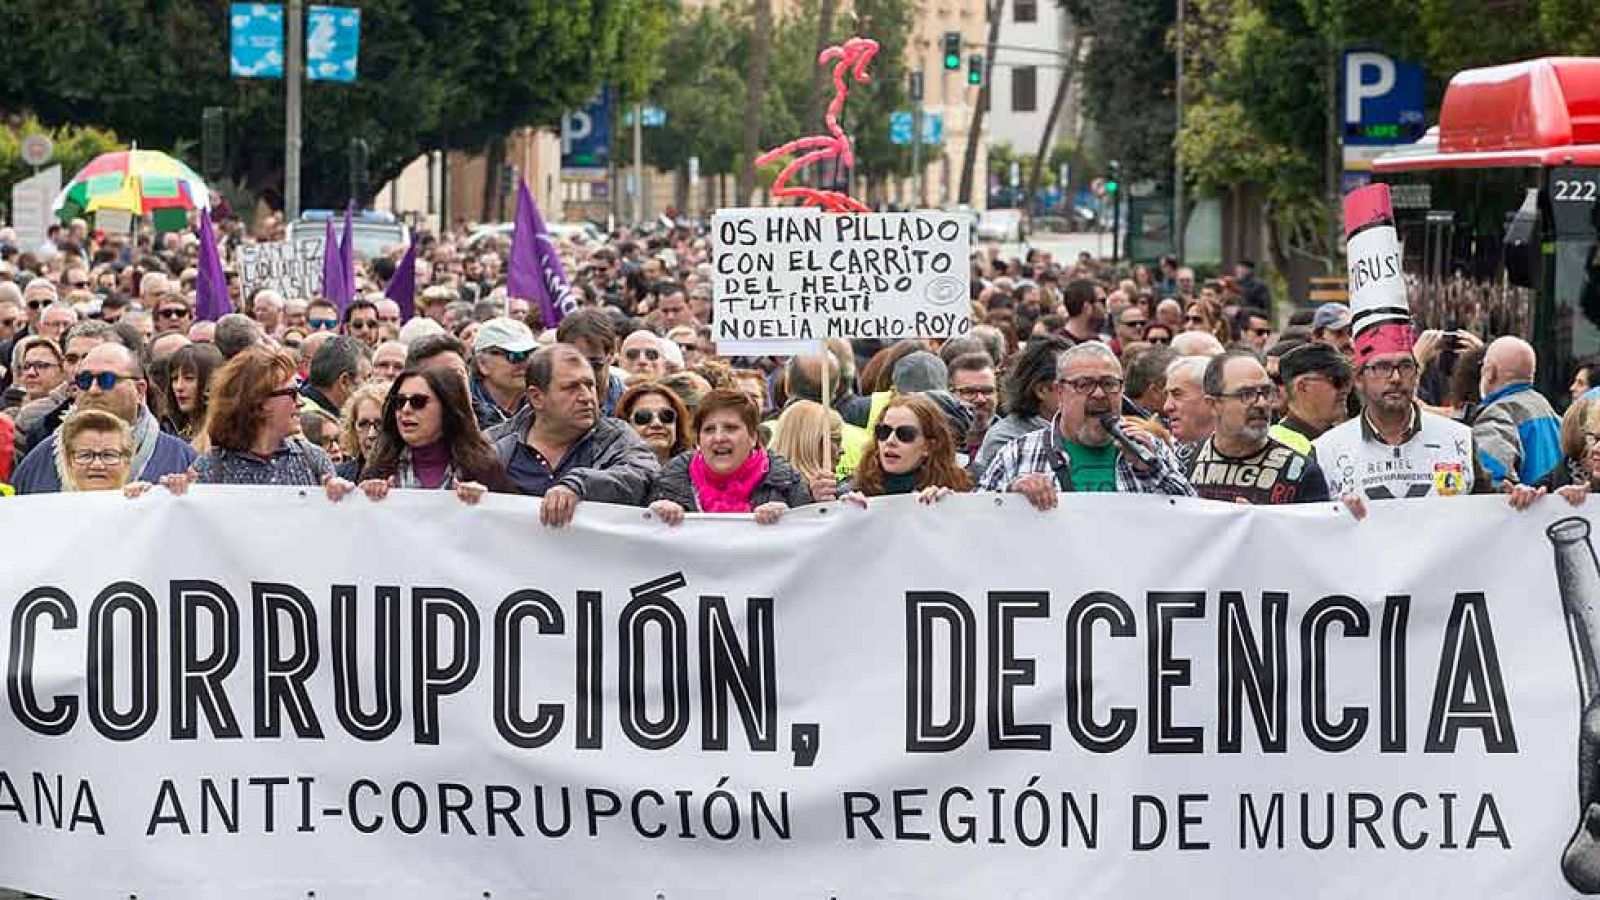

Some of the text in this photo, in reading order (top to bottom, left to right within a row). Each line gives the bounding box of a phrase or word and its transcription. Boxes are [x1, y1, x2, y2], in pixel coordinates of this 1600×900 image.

[1346, 53, 1396, 123] P
[561, 106, 592, 154] P
[1555, 180, 1597, 201] 222
[720, 212, 960, 246] OS HAN PILLADO
[717, 245, 952, 275] CON EL CARRITO
[725, 276, 912, 295] DEL HELADO
[720, 315, 812, 339] NOELIA
[7, 571, 1519, 767] CORRUPCIÓN, DECENCIA
[146, 775, 790, 839] ANTI-CORRUPCIÓN
[843, 775, 1098, 848] REGIÓN
[1132, 793, 1211, 851] DE
[1240, 792, 1512, 850] MURCIA
